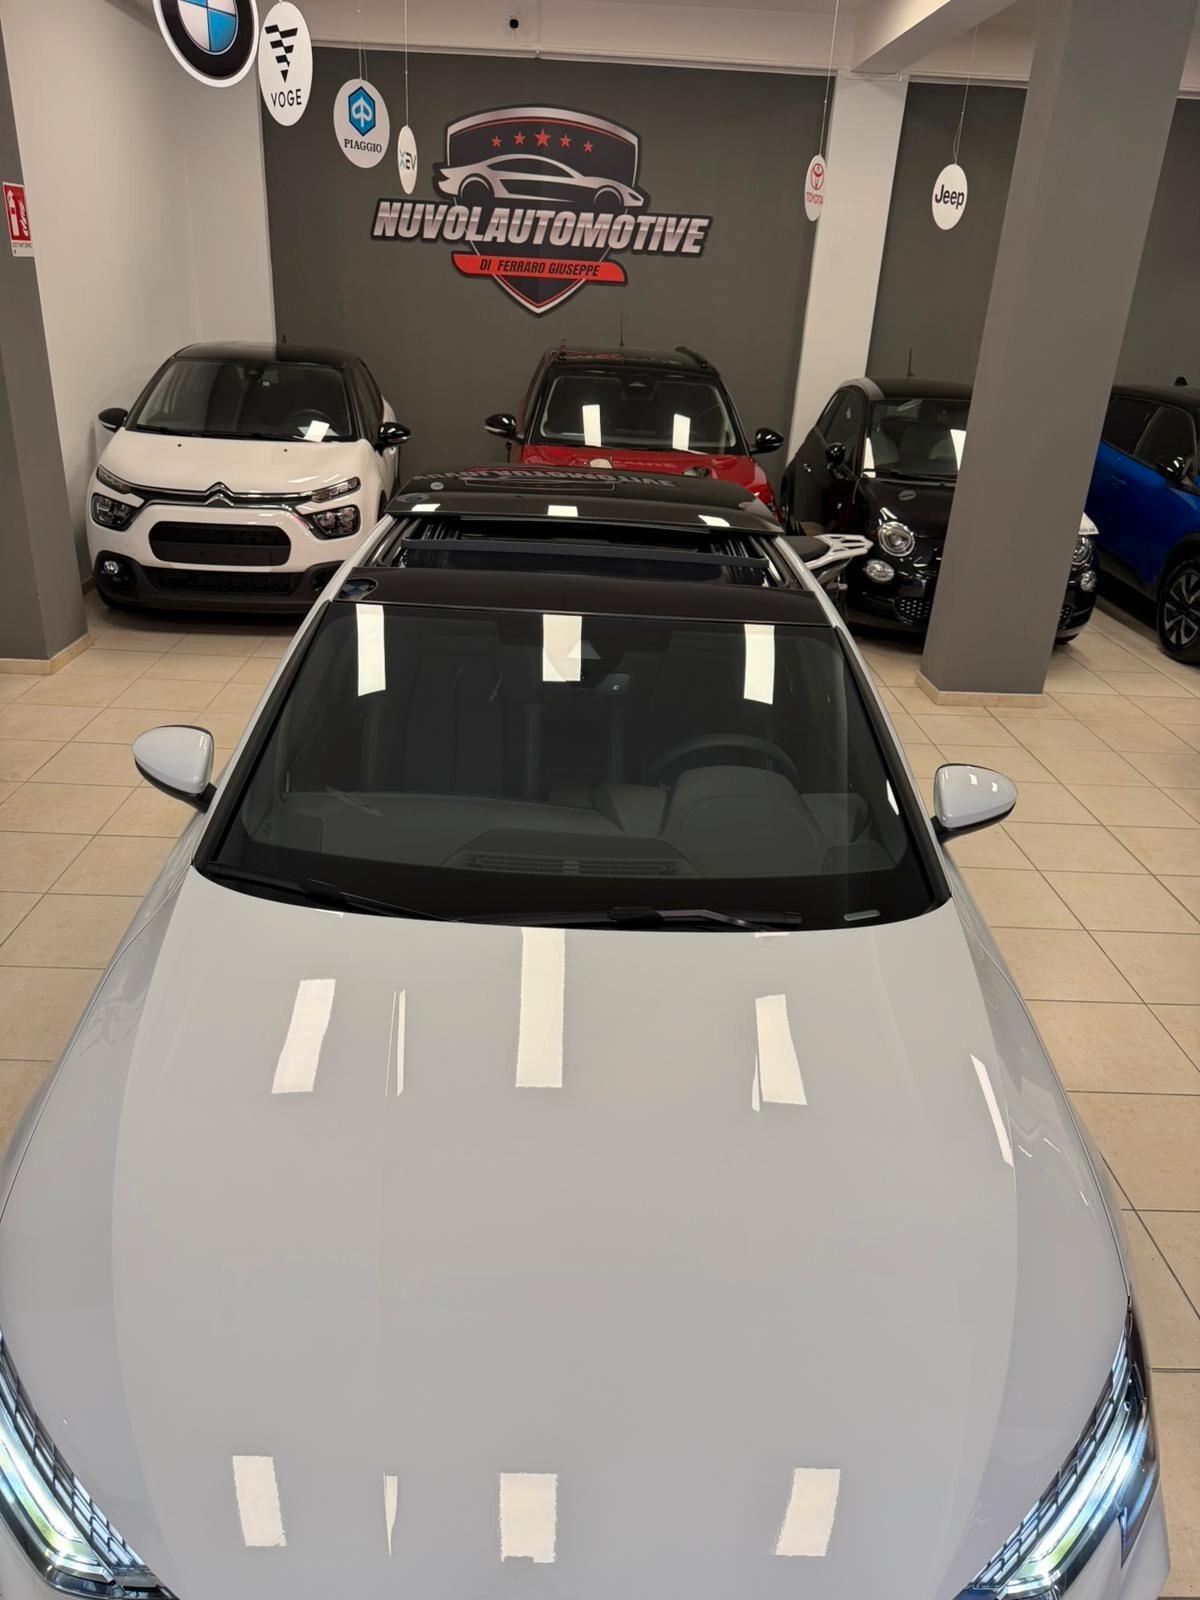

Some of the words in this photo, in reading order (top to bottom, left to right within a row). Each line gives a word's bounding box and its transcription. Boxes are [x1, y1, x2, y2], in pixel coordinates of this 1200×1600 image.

[270, 89, 302, 107] VOGE
[344, 139, 382, 153] PIAGGIO
[399, 150, 416, 170] XEV
[935, 184, 965, 209] Jeep
[373, 201, 709, 253] NUVOLAUTOMOTIVE
[480, 258, 492, 271] DI
[497, 259, 545, 274] FERRARO
[548, 262, 600, 277] GIUSEPPE
